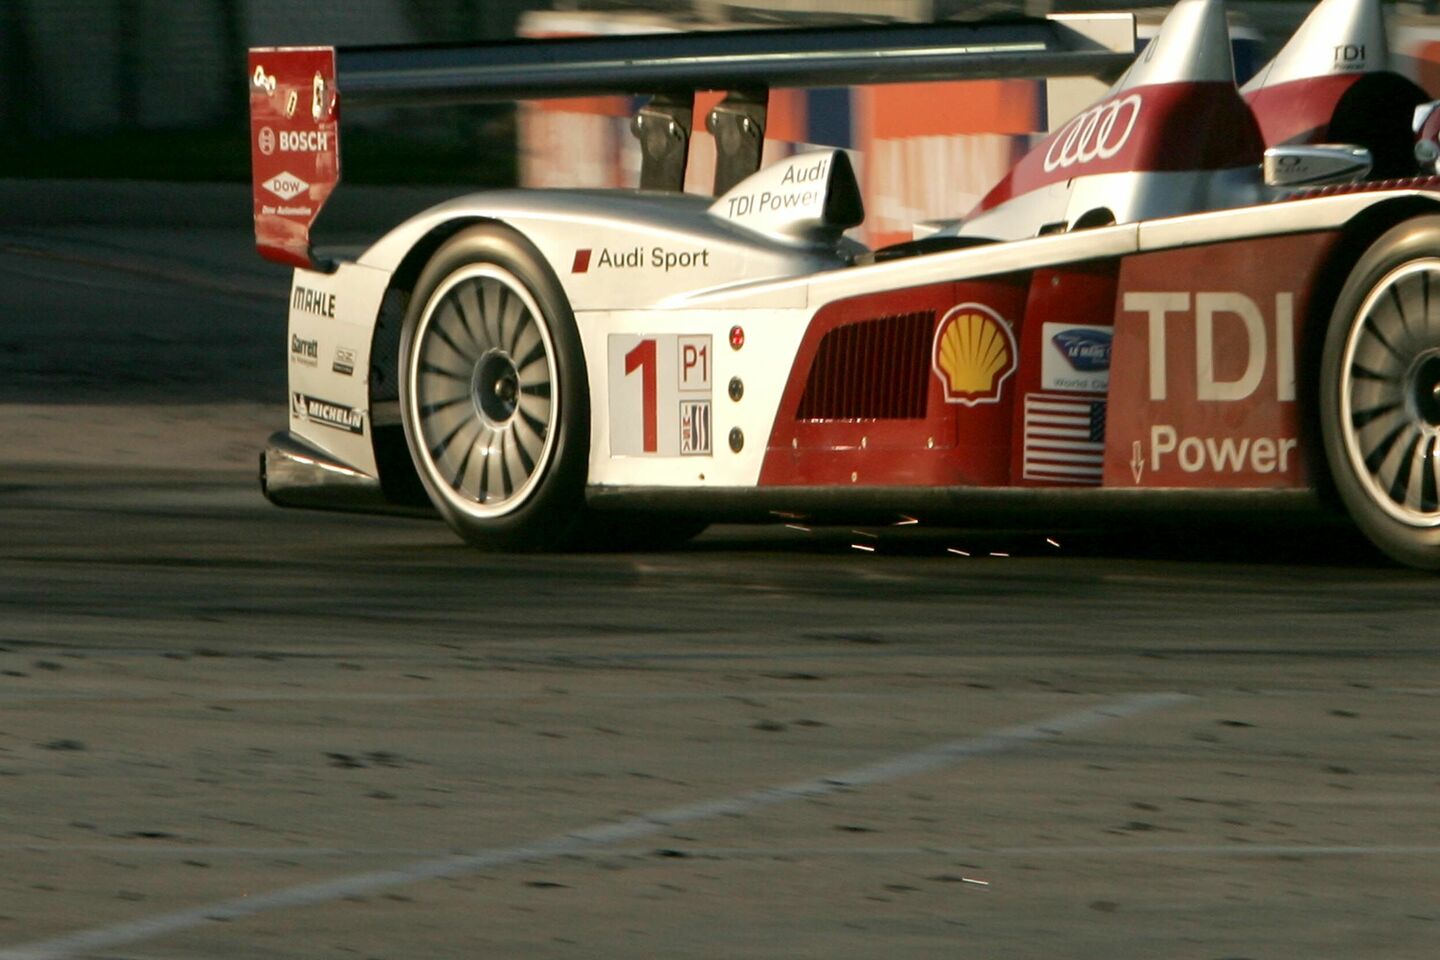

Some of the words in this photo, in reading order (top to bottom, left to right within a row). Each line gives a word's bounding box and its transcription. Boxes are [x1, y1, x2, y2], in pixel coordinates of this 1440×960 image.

[1333, 44, 1365, 61] TDI
[279, 131, 328, 152] BOSCH
[781, 159, 828, 185] Audi
[728, 194, 755, 219] TDI
[759, 191, 818, 212] Power
[598, 247, 644, 268] Audi
[651, 247, 710, 272] Sport
[293, 286, 336, 318] MAHLE
[291, 333, 318, 359] Garrett
[1123, 292, 1297, 401] TDI
[683, 344, 707, 382] P1
[624, 339, 657, 452] 1
[308, 400, 362, 429] MICHELIN
[1151, 424, 1297, 474] Power
